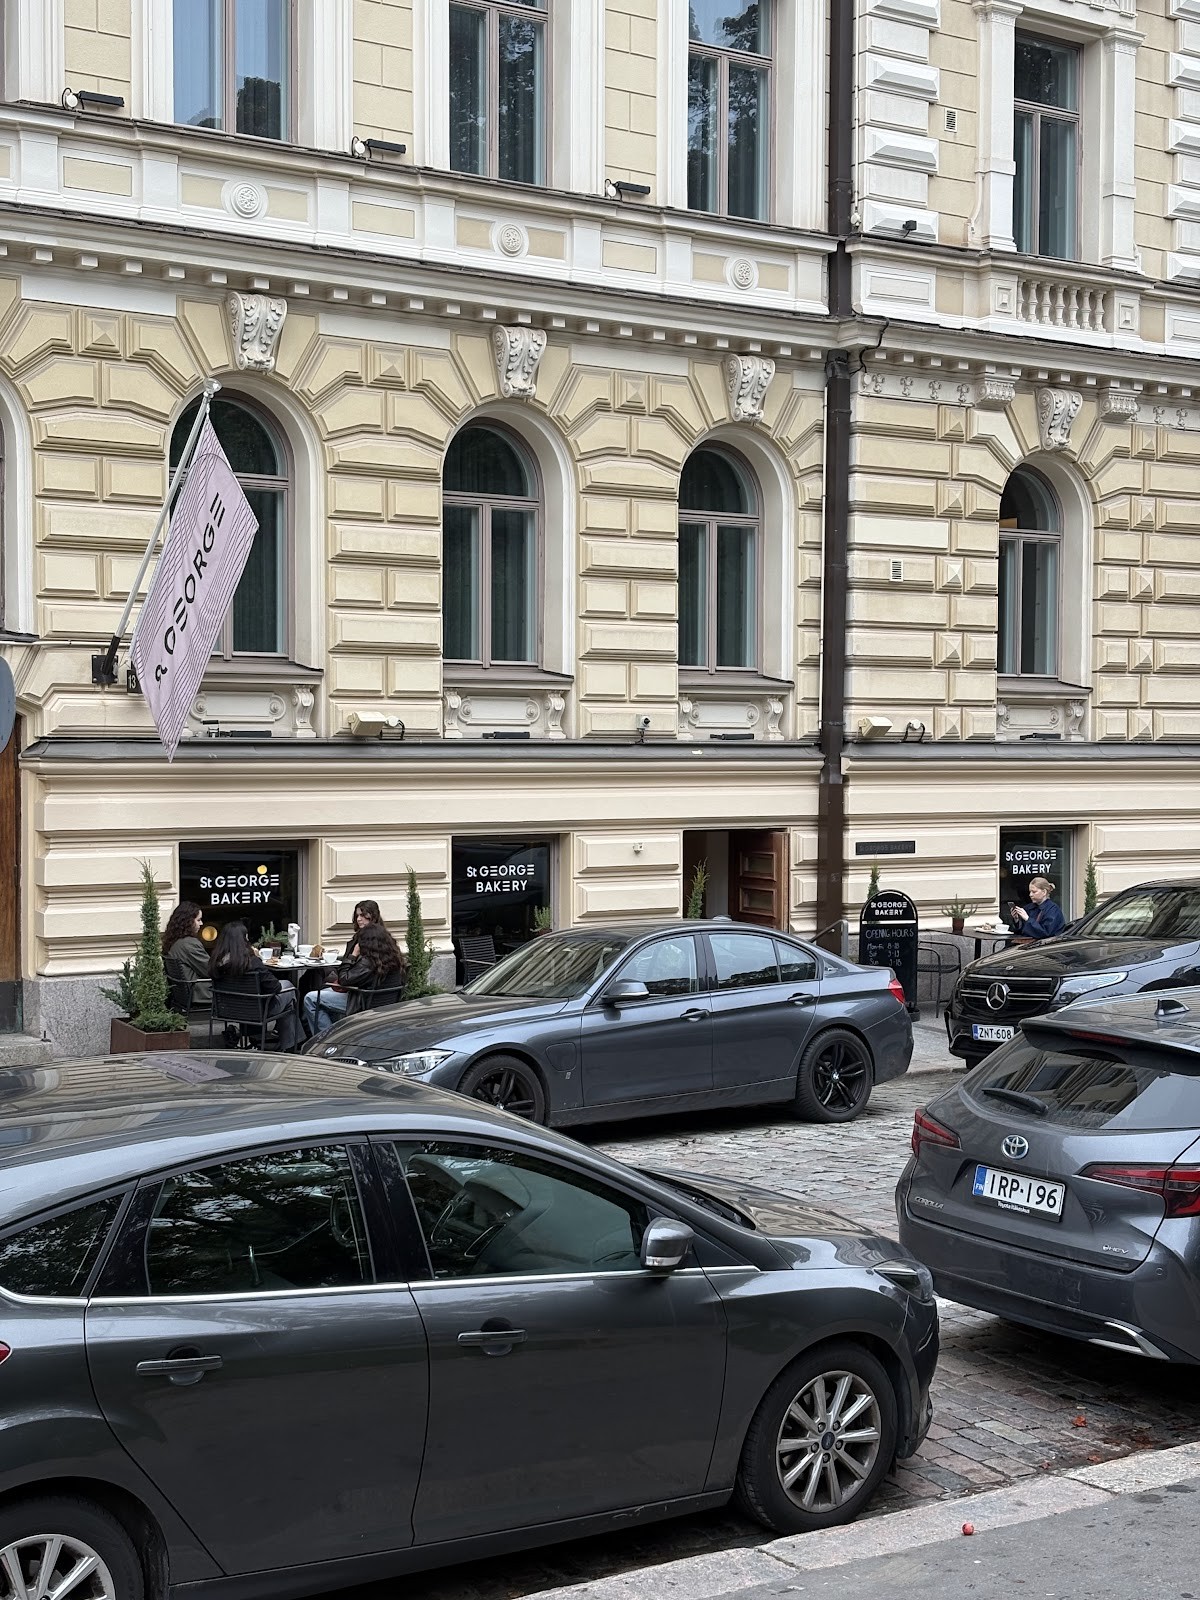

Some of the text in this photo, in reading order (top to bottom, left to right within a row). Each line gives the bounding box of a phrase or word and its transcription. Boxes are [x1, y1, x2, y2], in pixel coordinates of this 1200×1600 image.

[128, 675, 137, 689] 13
[1005, 850, 1057, 861] St GEORGE
[466, 864, 535, 878] St GEORGE
[1012, 864, 1051, 875] BAKERY
[200, 874, 280, 889] St GEORGE
[476, 880, 528, 893] BAKERY
[211, 891, 271, 905] BAKERY
[891, 928, 915, 938] HOURS
[978, 1027, 1012, 1040] ZNT-608
[975, 1183, 985, 1191] FIN
[990, 1174, 1058, 1209] IRP-196
